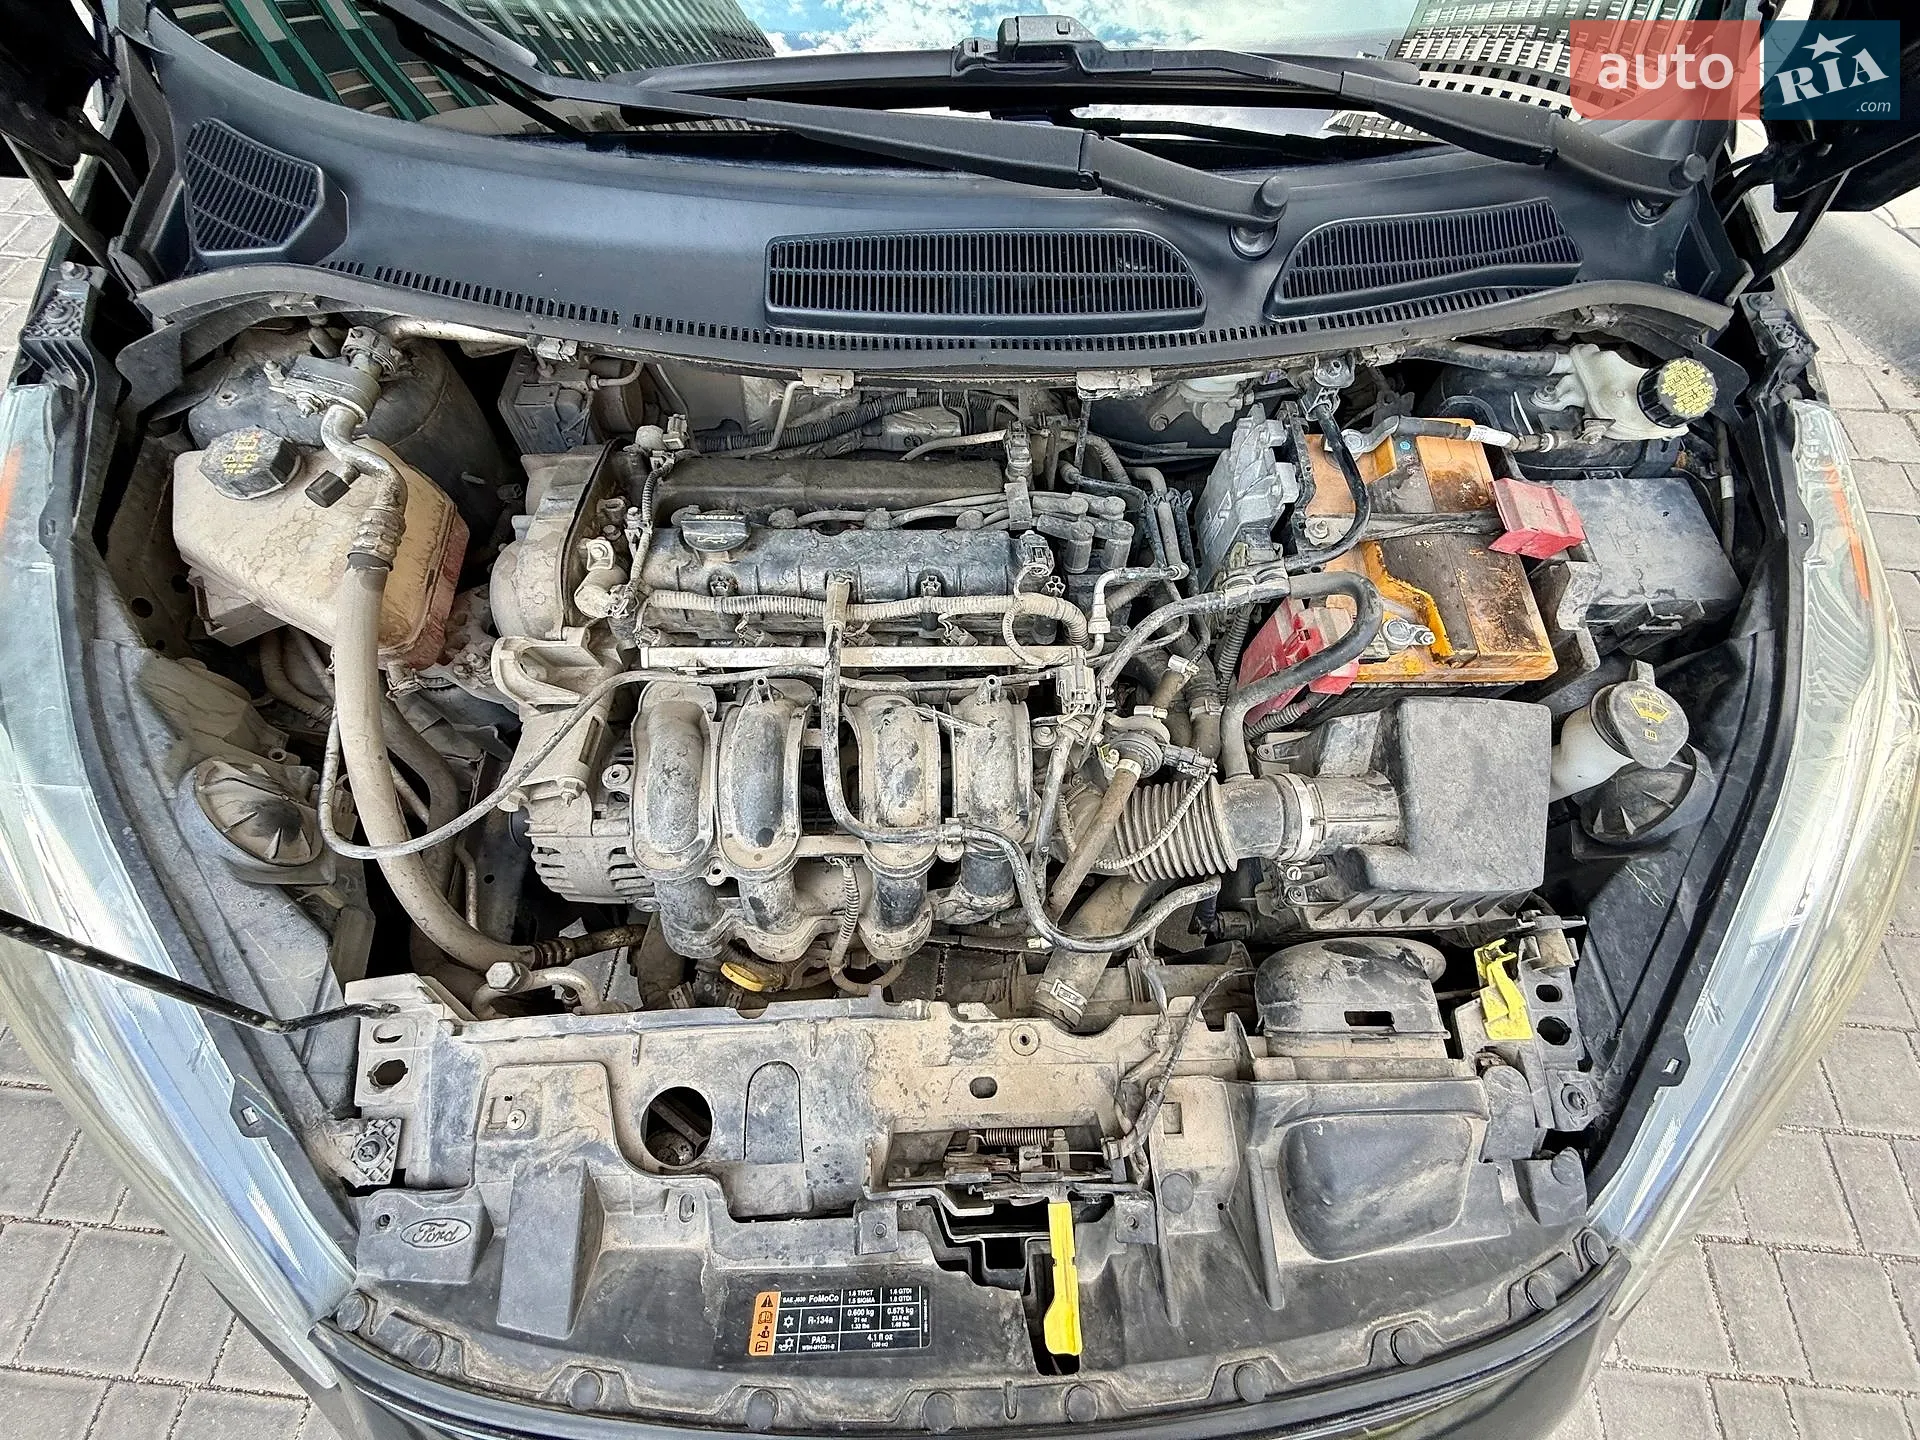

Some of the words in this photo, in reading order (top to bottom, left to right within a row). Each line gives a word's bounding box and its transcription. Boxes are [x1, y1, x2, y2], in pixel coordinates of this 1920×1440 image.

[412, 1222, 460, 1243] Ford
[808, 1294, 839, 1303] FoMoCo
[866, 1308, 875, 1317] kg
[905, 1306, 914, 1315] kg
[807, 1316, 834, 1324] R-134a
[811, 1336, 827, 1344] PAG
